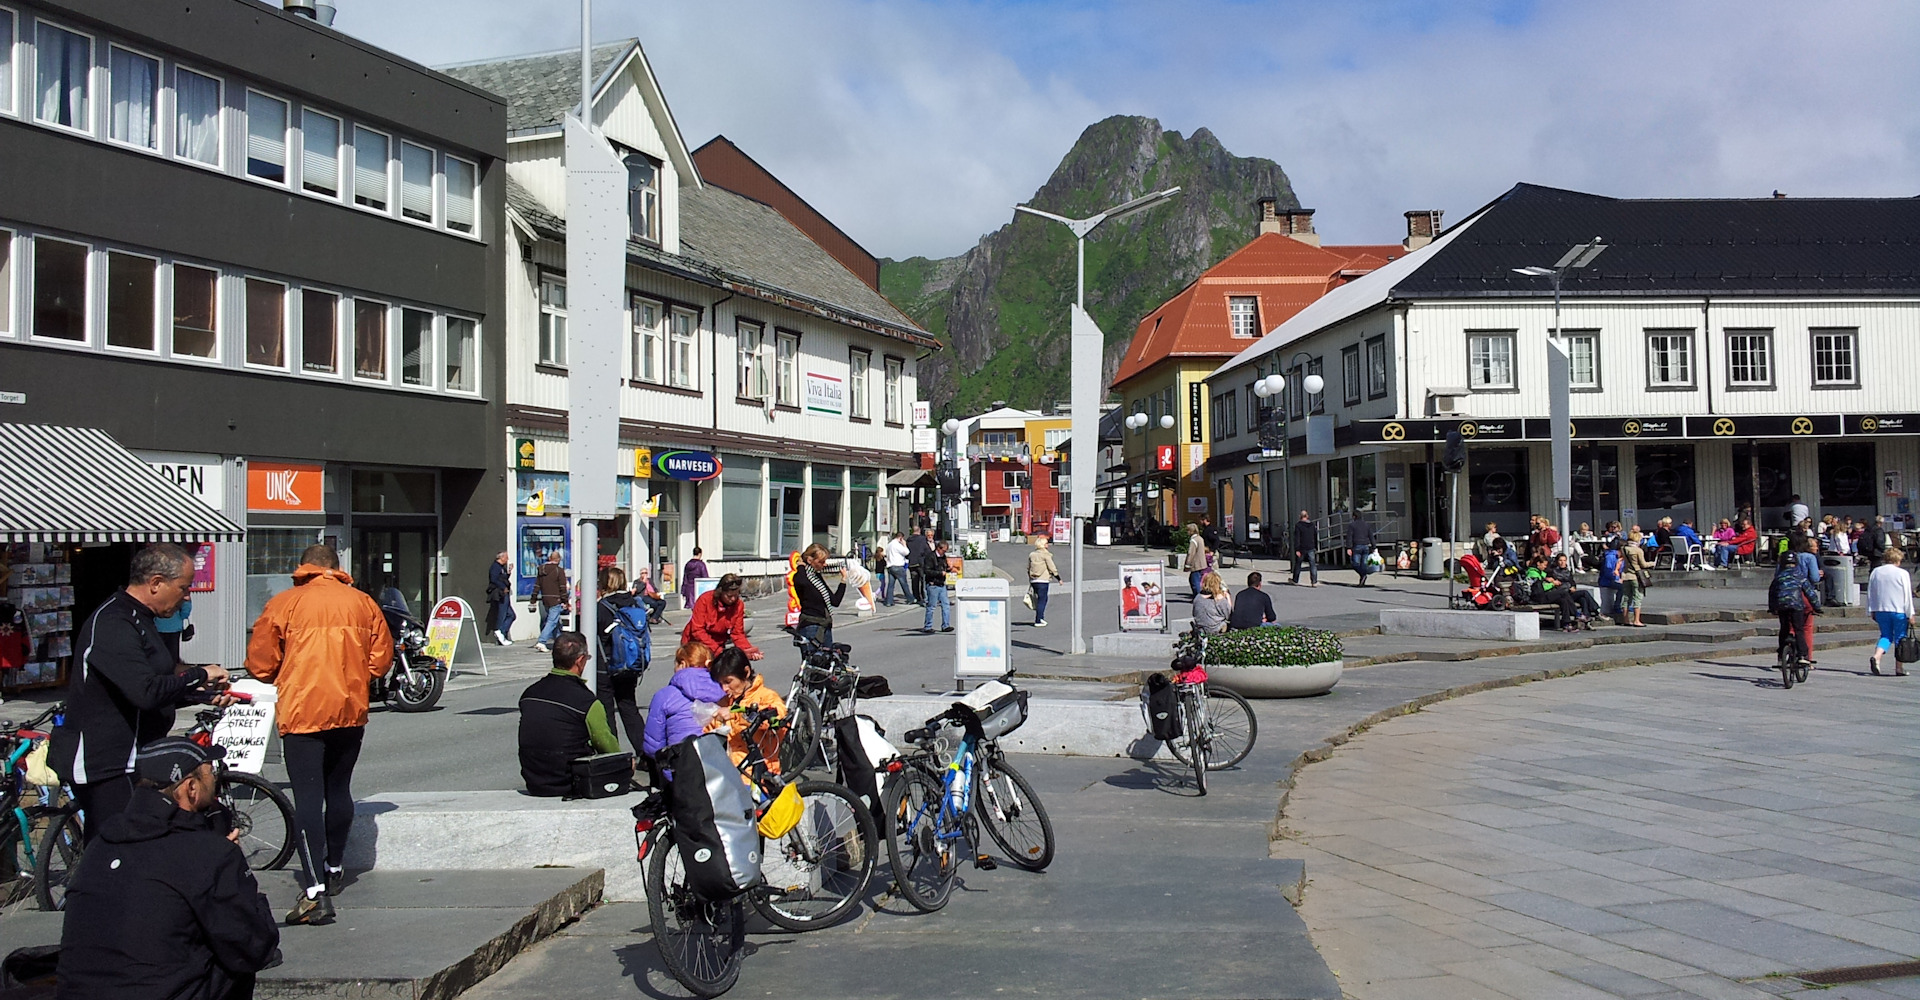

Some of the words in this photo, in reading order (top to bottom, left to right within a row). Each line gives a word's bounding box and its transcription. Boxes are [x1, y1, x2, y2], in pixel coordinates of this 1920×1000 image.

[807, 379, 822, 396] Viva
[824, 383, 842, 400] Italia
[1, 393, 19, 402] Torget
[915, 407, 927, 419] PUB
[668, 458, 713, 473] NARVESEN
[266, 469, 302, 503] UNIK
[228, 708, 267, 718] WALKING
[228, 718, 261, 728] STREET
[226, 749, 251, 760] ZONE
